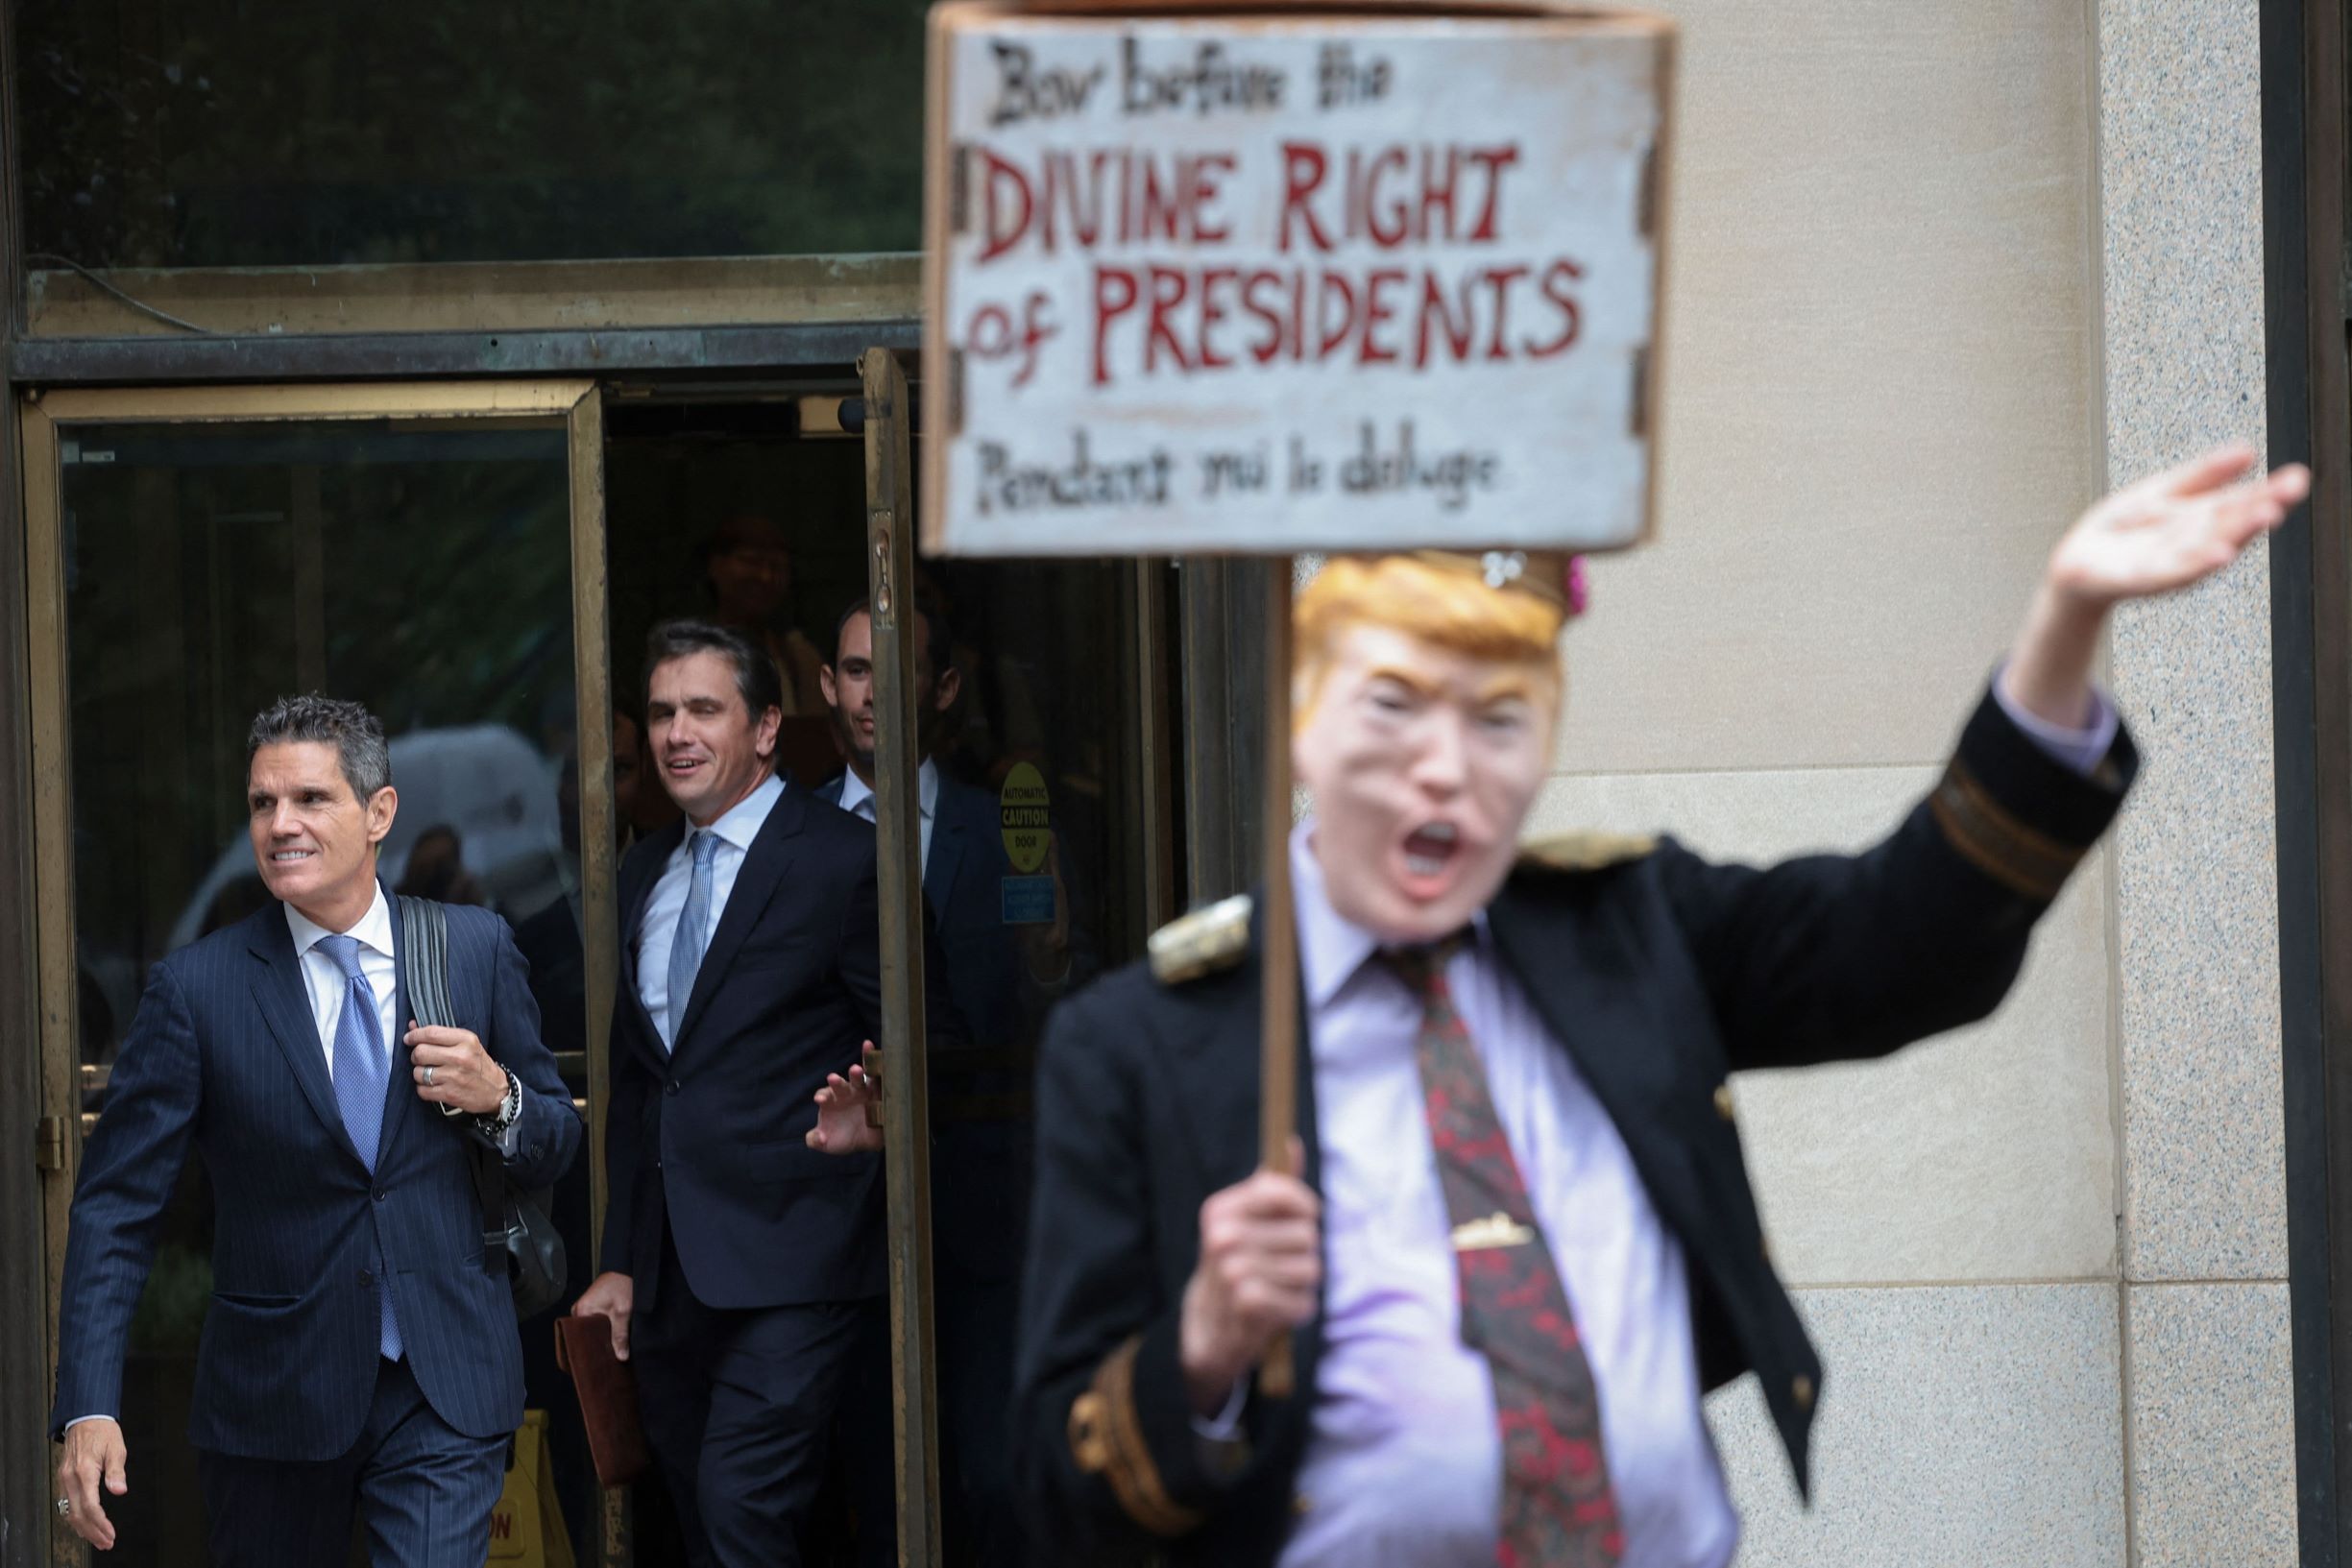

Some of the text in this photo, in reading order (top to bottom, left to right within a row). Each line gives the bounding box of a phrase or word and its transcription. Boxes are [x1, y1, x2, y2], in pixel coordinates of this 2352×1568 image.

[990, 36, 1392, 127] Bow before the
[975, 141, 1519, 264] DIVINE RIGHT
[966, 258, 1587, 386] of PRESIDENTS
[1003, 808, 1049, 826] CAUTION
[1004, 786, 1046, 800] AUTOMATIC
[1015, 835, 1037, 848] DOOR
